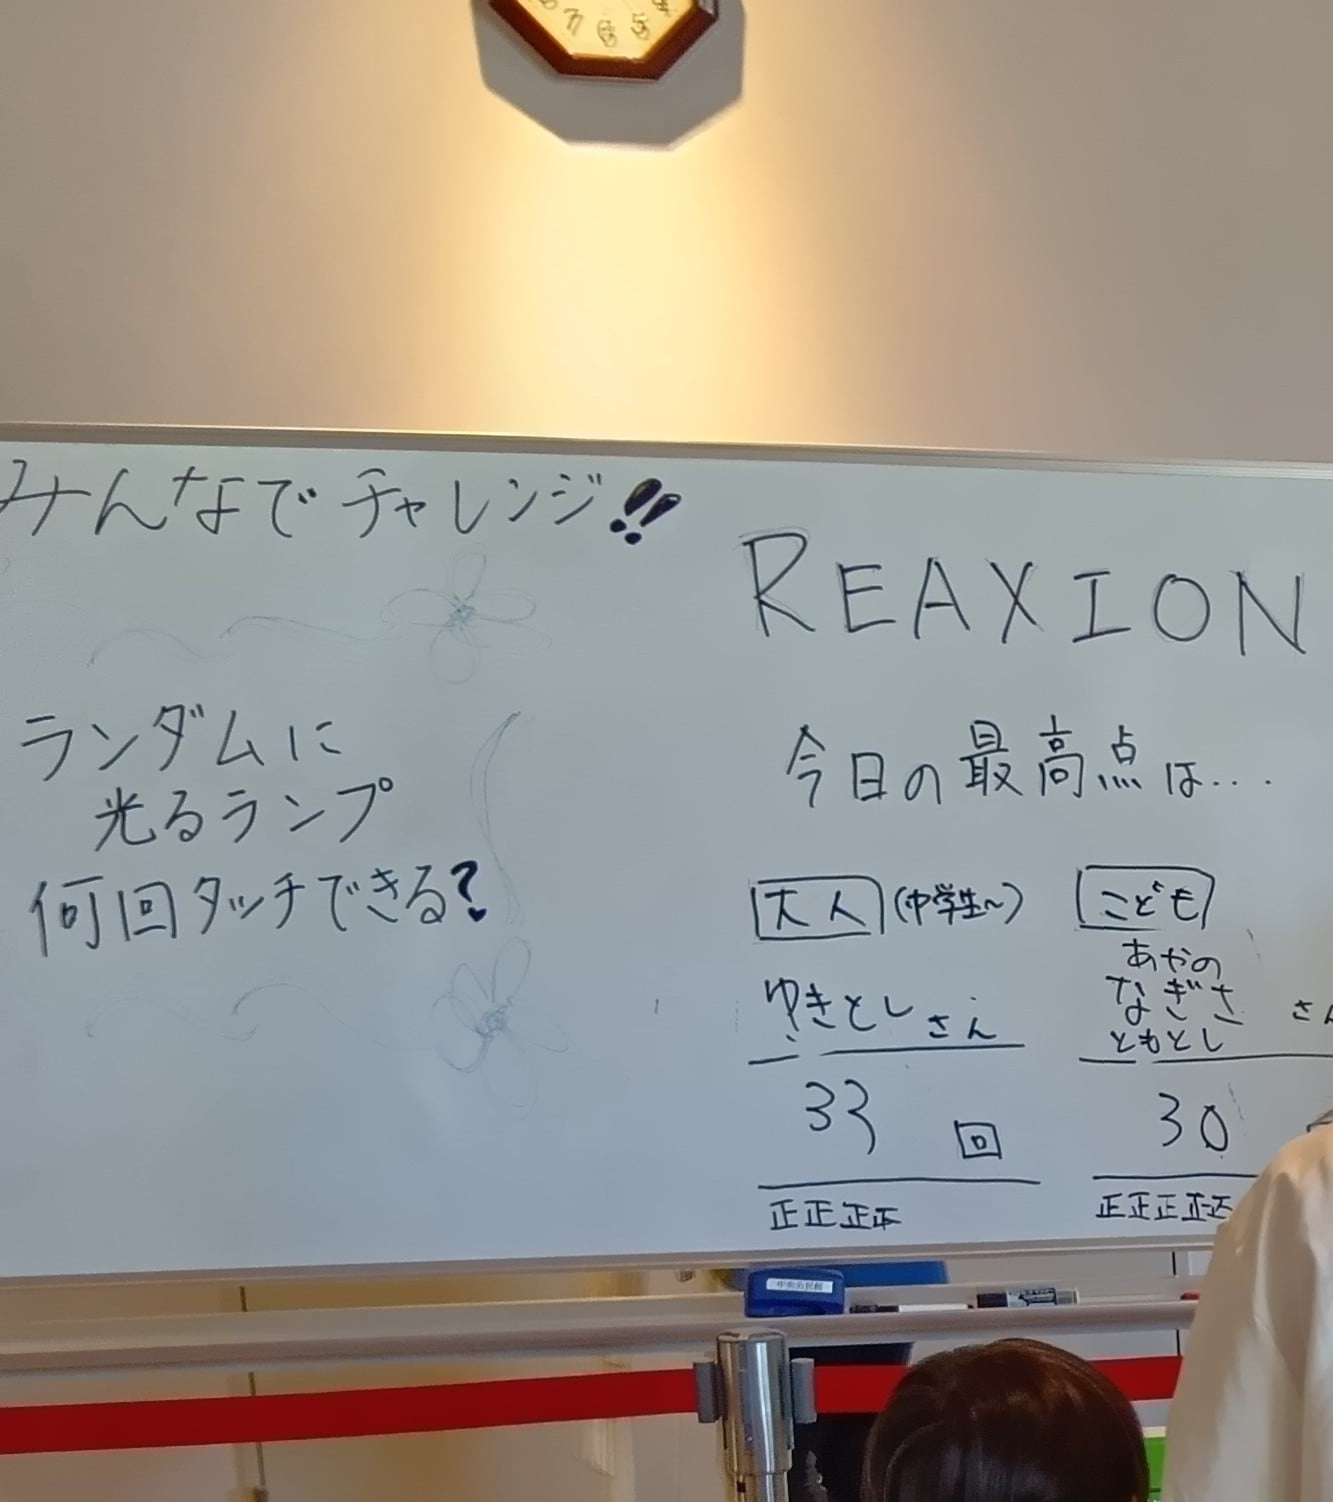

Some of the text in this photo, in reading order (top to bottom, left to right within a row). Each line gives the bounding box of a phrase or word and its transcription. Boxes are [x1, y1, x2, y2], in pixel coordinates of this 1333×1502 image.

[741, 530, 1307, 656] REAXION
[20, 703, 342, 781] ランダムに
[93, 776, 394, 852] 光るランプ
[29, 860, 488, 957] 何回タッチできる?
[763, 887, 867, 931] 大人
[1101, 878, 1202, 922] こども
[1122, 938, 1223, 980] あやの
[1105, 974, 1244, 1027] なぎさ
[954, 1119, 1003, 1161] 回
[1158, 1091, 1230, 1154] 30
